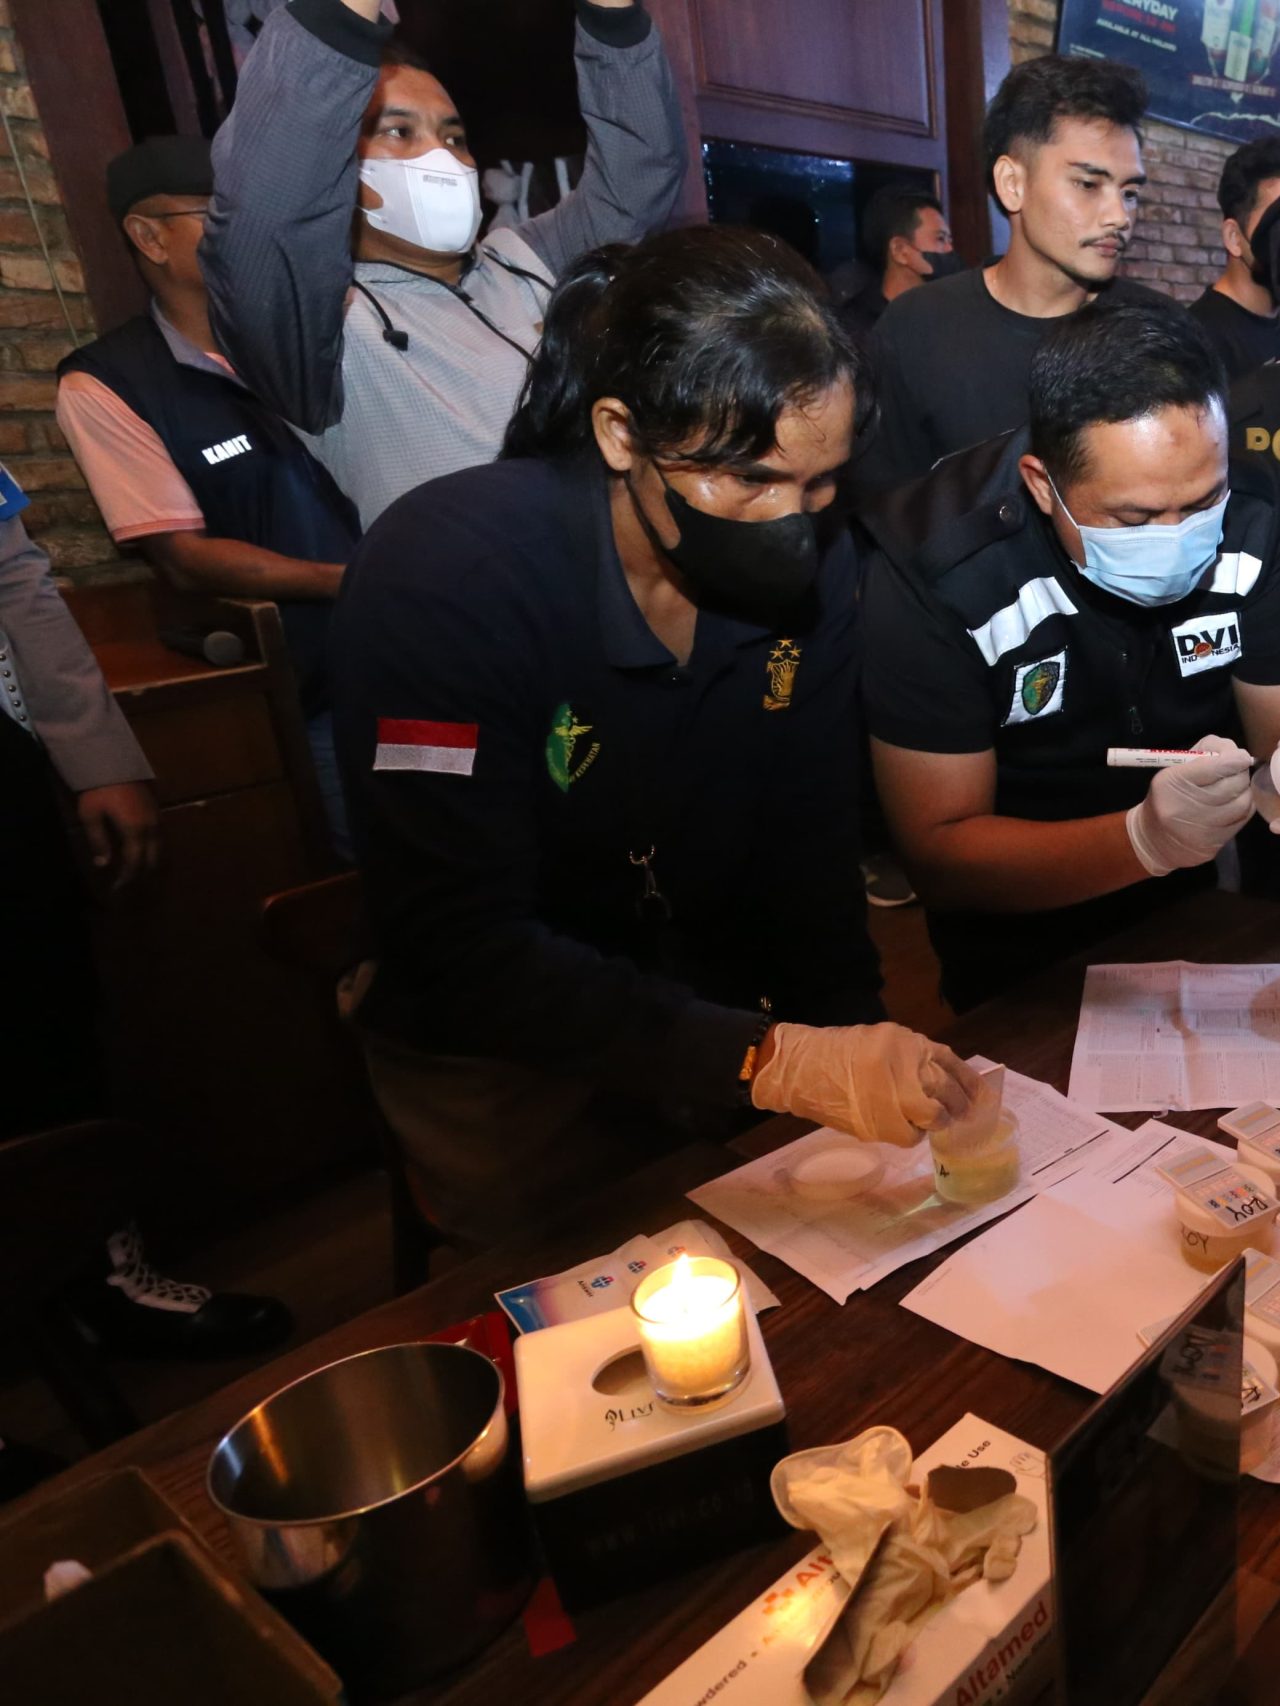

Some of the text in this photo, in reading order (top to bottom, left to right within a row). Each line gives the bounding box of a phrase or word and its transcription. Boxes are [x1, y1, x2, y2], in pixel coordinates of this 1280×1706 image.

[201, 434, 253, 465] KANIT
[1176, 624, 1239, 657] DVI
[967, 1440, 992, 1459] Use
[955, 1599, 1049, 1706] Altamed
